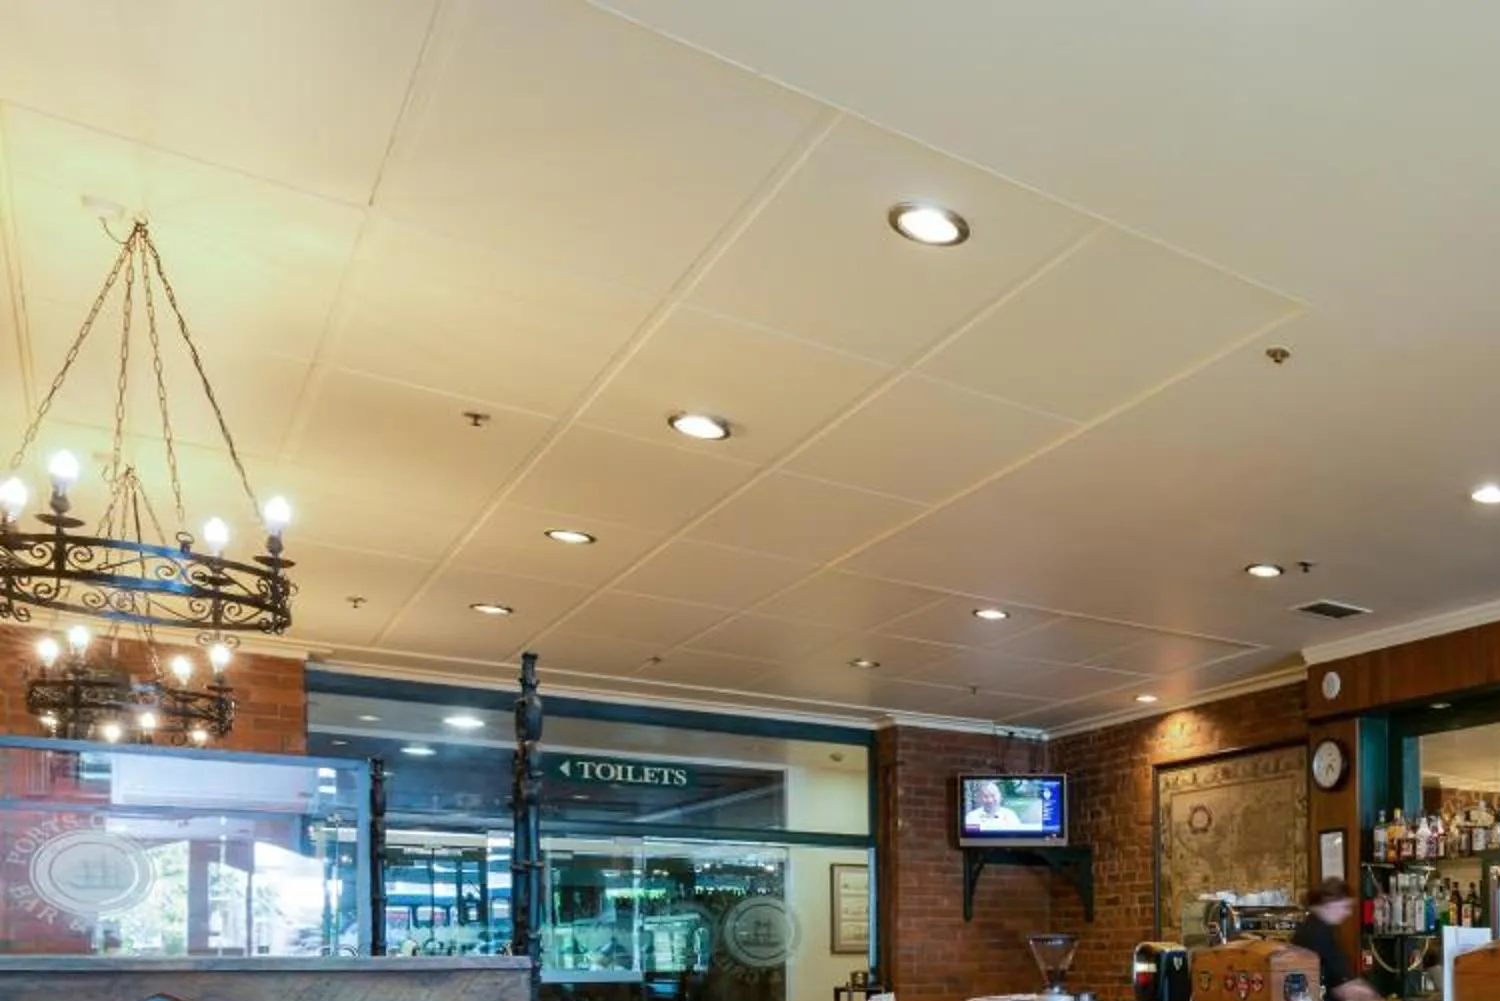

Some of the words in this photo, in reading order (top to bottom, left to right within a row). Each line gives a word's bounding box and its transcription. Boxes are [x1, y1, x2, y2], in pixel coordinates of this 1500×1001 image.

[577, 760, 687, 786] TOILETS
[6, 814, 79, 865] PORTS
[9, 885, 58, 925] BAR
